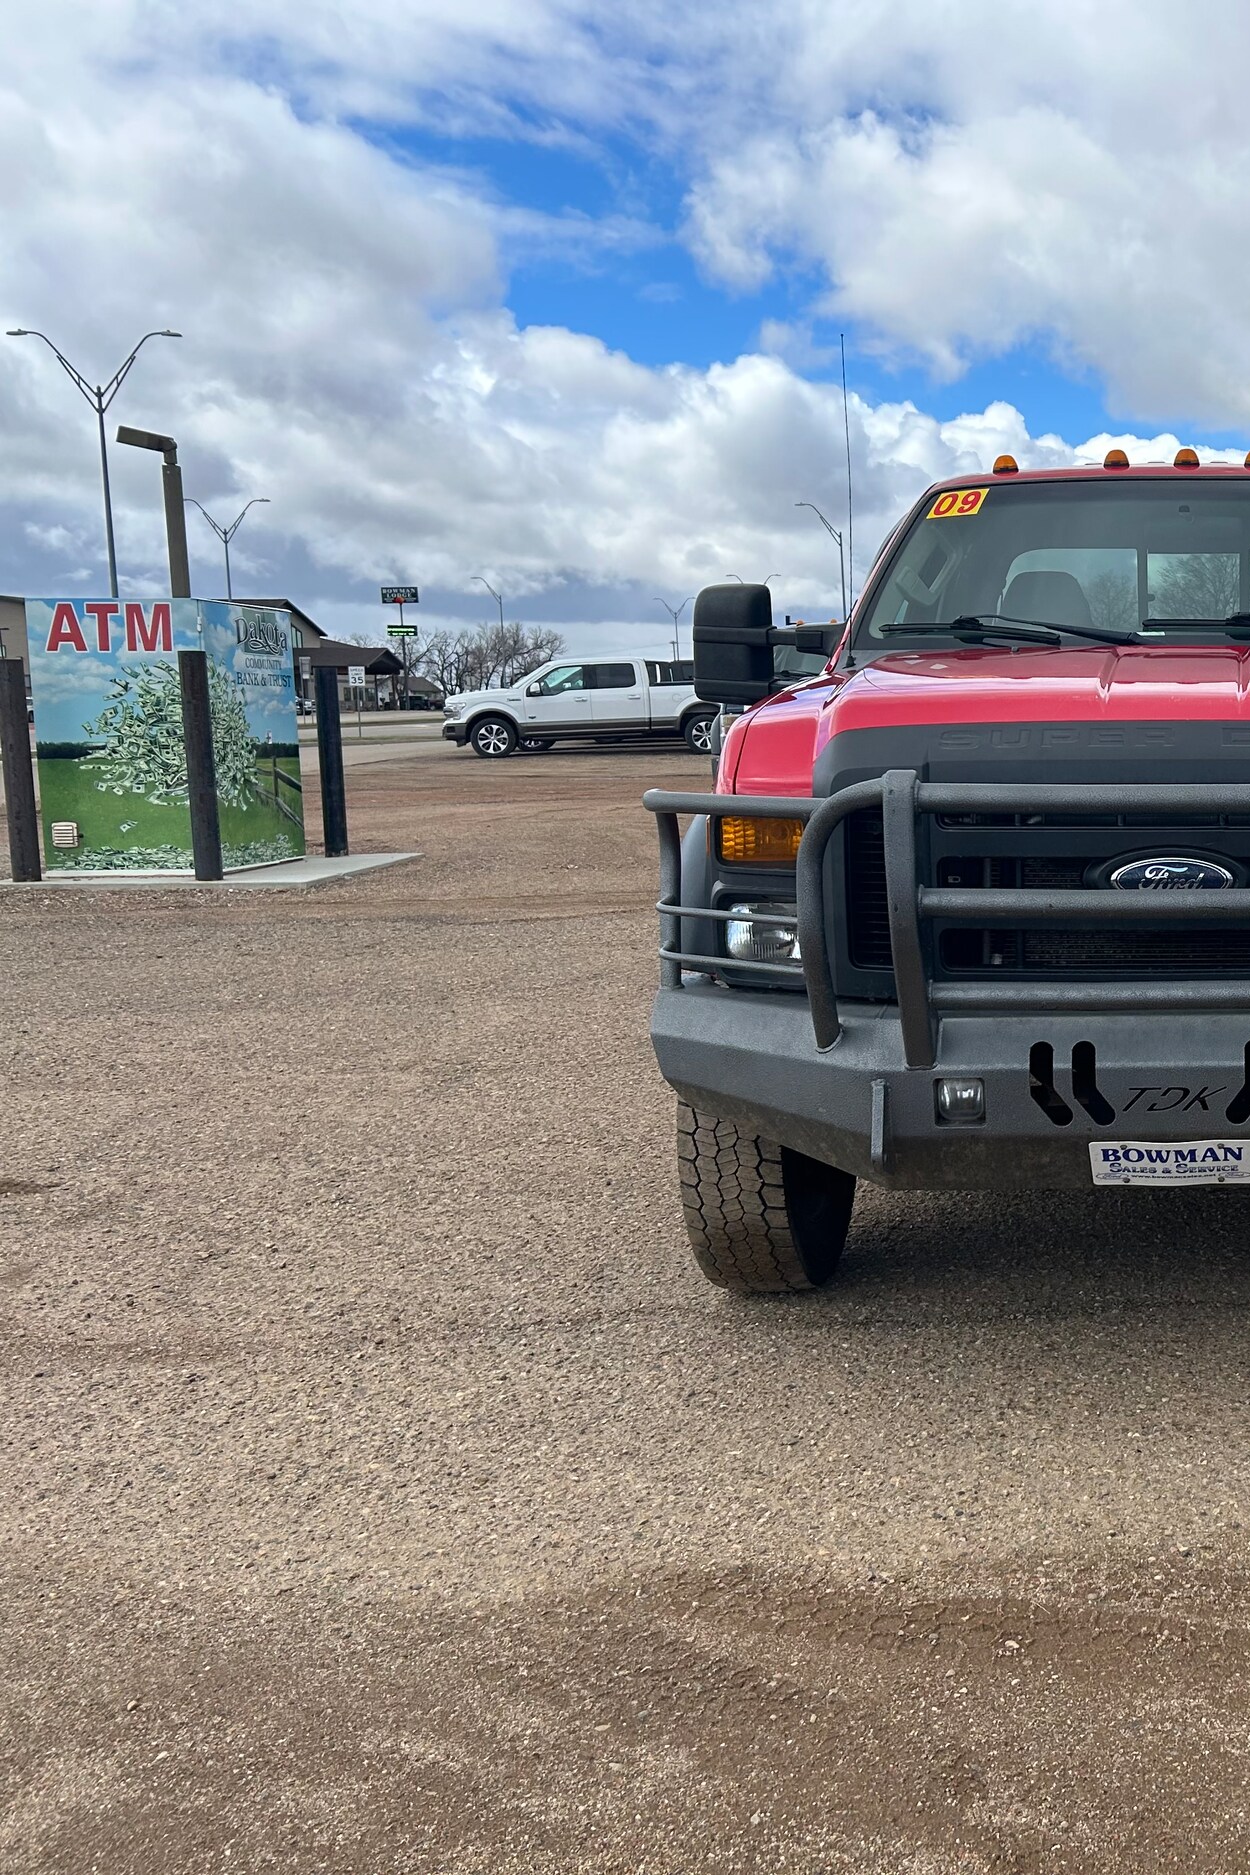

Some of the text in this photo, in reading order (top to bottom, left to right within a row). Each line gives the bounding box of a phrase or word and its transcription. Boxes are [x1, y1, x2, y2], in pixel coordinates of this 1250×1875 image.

[933, 490, 982, 516] 09
[46, 603, 173, 652] ATM
[234, 614, 288, 655] Dakota
[245, 657, 282, 670] COMMUNITY
[236, 671, 292, 688] BANK & TRUST
[351, 676, 364, 684] 35
[938, 727, 1176, 750] SUPER
[1138, 865, 1205, 889] Ford
[1122, 1086, 1228, 1112] TDK
[1100, 1147, 1244, 1163] BOWMAN
